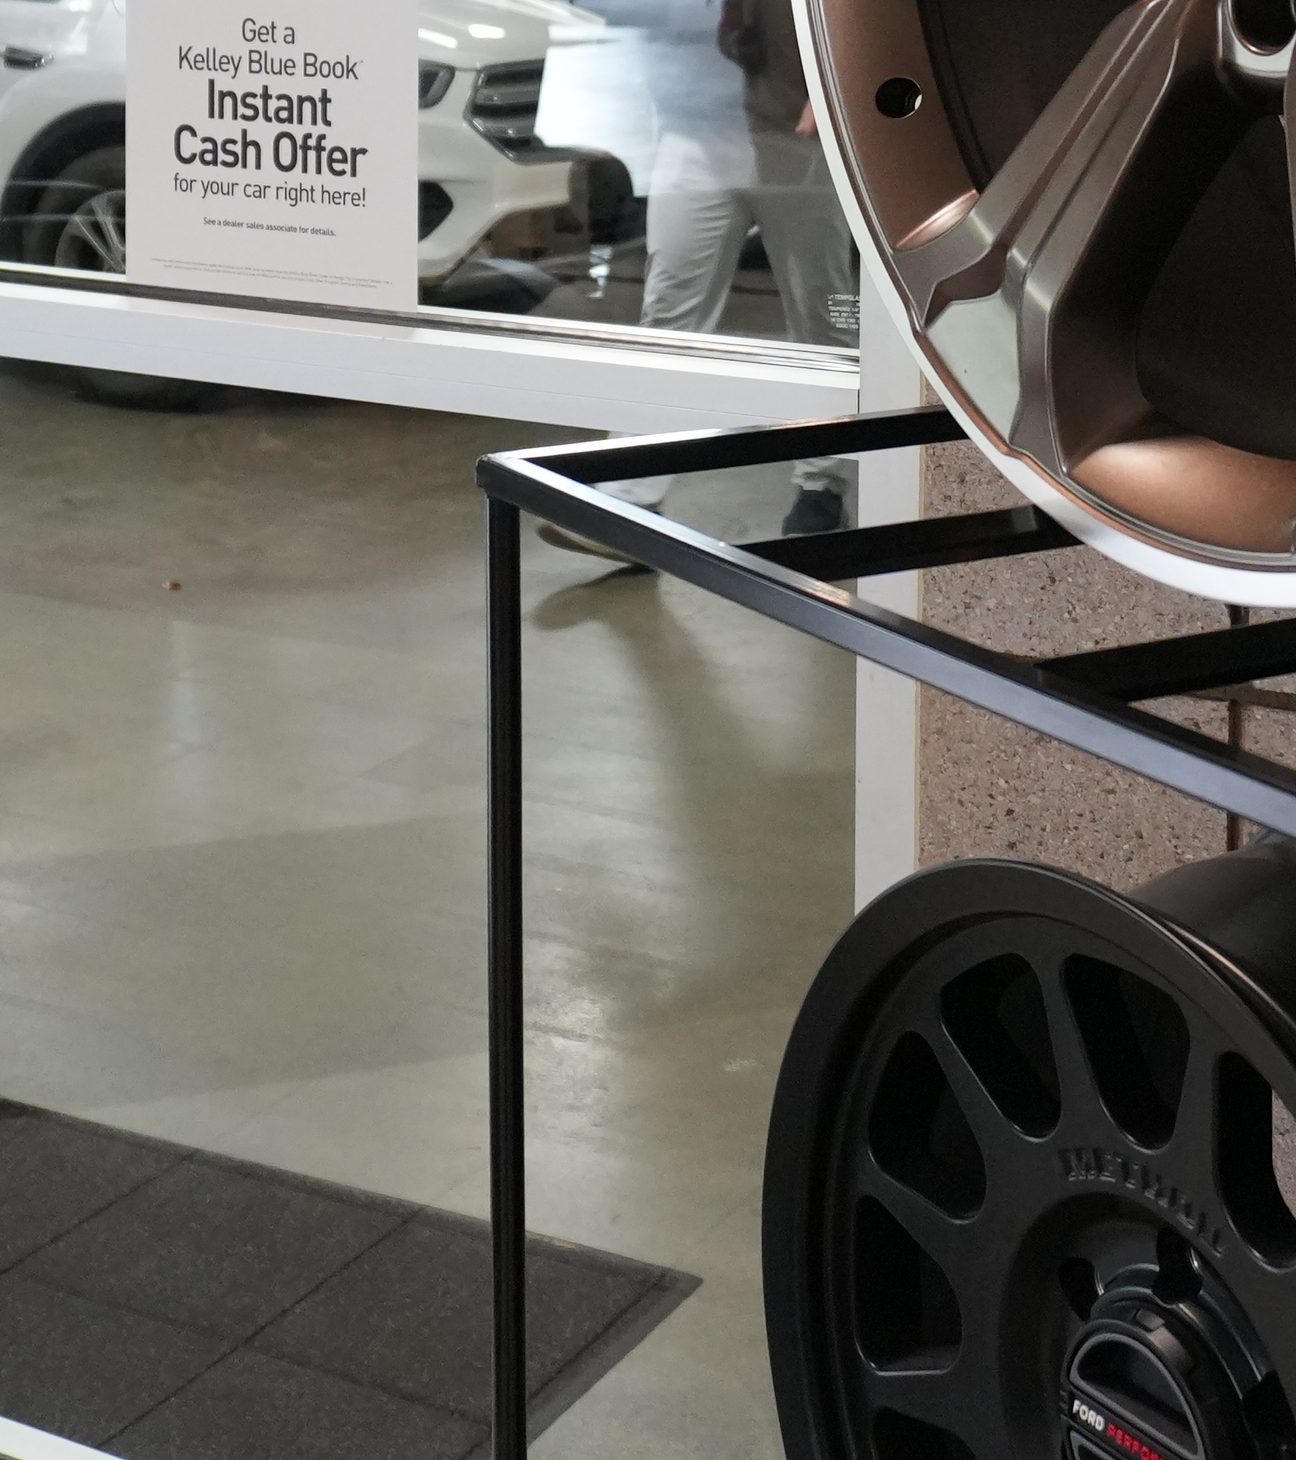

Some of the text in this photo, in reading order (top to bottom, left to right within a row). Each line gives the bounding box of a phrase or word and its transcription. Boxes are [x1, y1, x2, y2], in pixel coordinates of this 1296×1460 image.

[241, 17, 296, 45] Get a
[178, 45, 360, 81] Kelley Blue Book
[207, 78, 332, 128] Instant
[173, 123, 369, 178] Cash Offer
[173, 172, 366, 208] for your car right here!
[203, 216, 336, 237] See a dealer sales associate for details.
[1072, 1399, 1105, 1431] FORD
